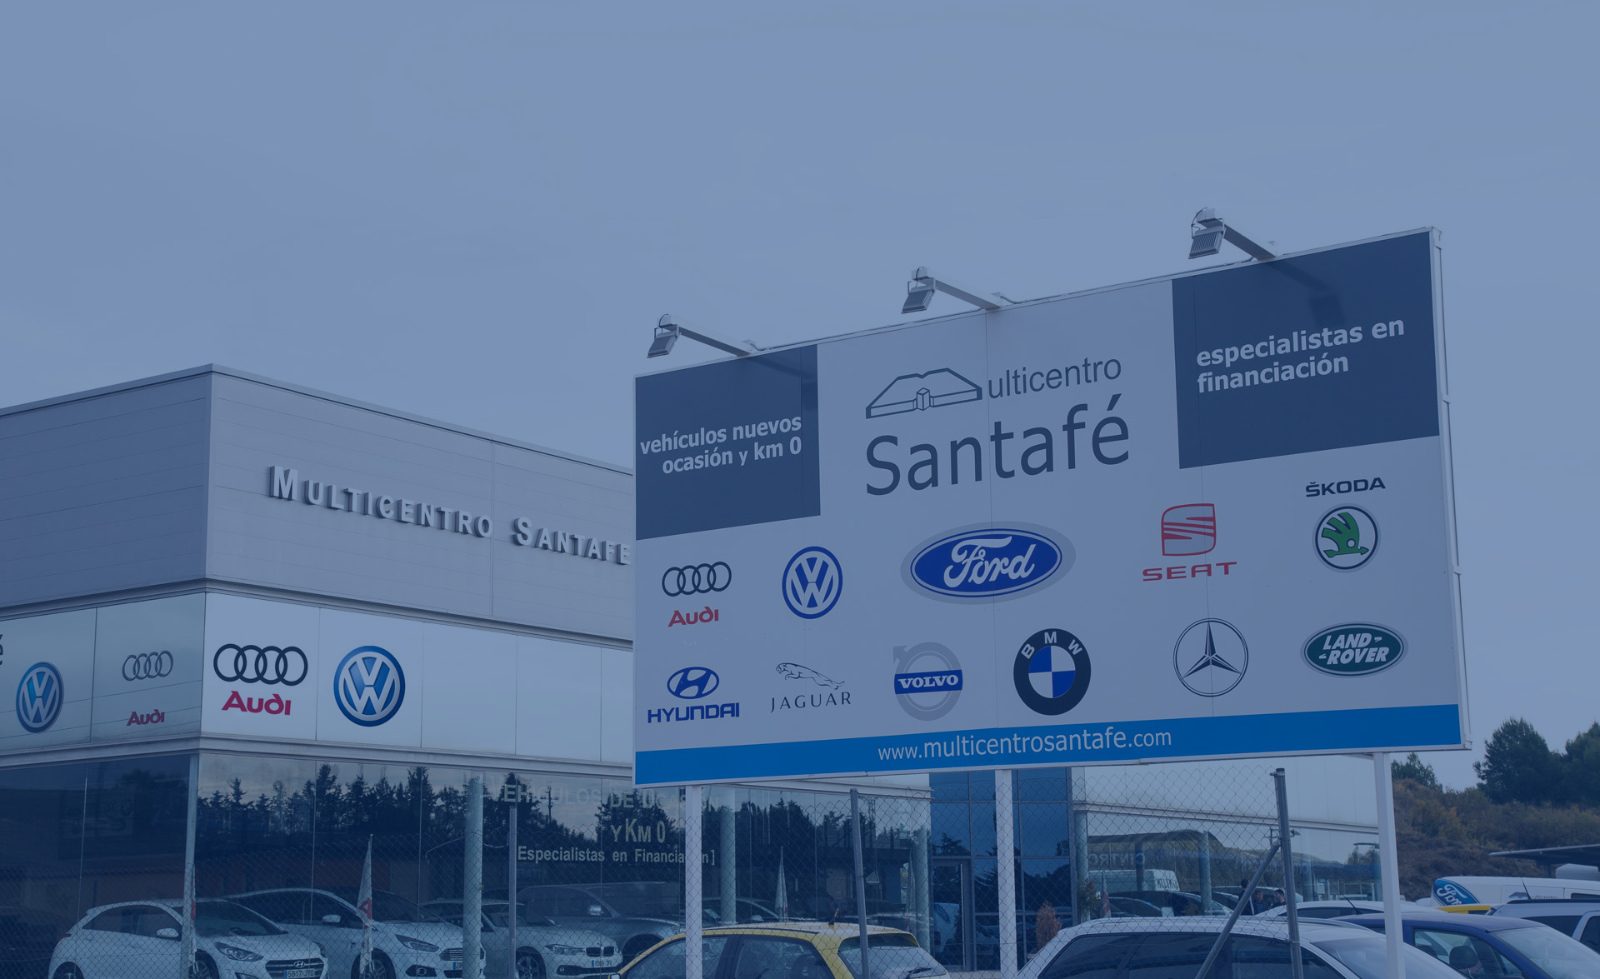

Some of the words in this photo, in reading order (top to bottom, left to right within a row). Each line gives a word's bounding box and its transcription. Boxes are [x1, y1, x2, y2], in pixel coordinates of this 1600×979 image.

[1196, 321, 1363, 368] especialistas
[1372, 317, 1405, 341] en
[987, 356, 1122, 399] ulticentro
[1196, 353, 1349, 393] financiación
[640, 425, 727, 455] vehículos
[733, 415, 802, 442] nuevos
[865, 393, 1130, 496] Santafé
[662, 445, 733, 474] ocasión
[738, 450, 749, 467] y
[754, 440, 784, 463] km
[789, 435, 802, 455] 0
[1305, 476, 1386, 497] ŠKODA
[268, 464, 494, 540] MULTICENTRO
[511, 516, 632, 566] SANTAFE
[943, 535, 1037, 588] Ford
[1142, 561, 1238, 582] SEAT
[668, 606, 720, 628] Audi
[1020, 631, 1083, 660] BMW
[897, 674, 960, 690] VOLVO
[221, 690, 292, 716] Audi
[647, 701, 741, 723] HYUNDAI
[770, 690, 852, 714] JAGUAR
[127, 707, 166, 728] Audi
[878, 727, 1173, 761] www.multicentrosantafe.com
[517, 845, 605, 864] Especialistas
[612, 850, 628, 863] en
